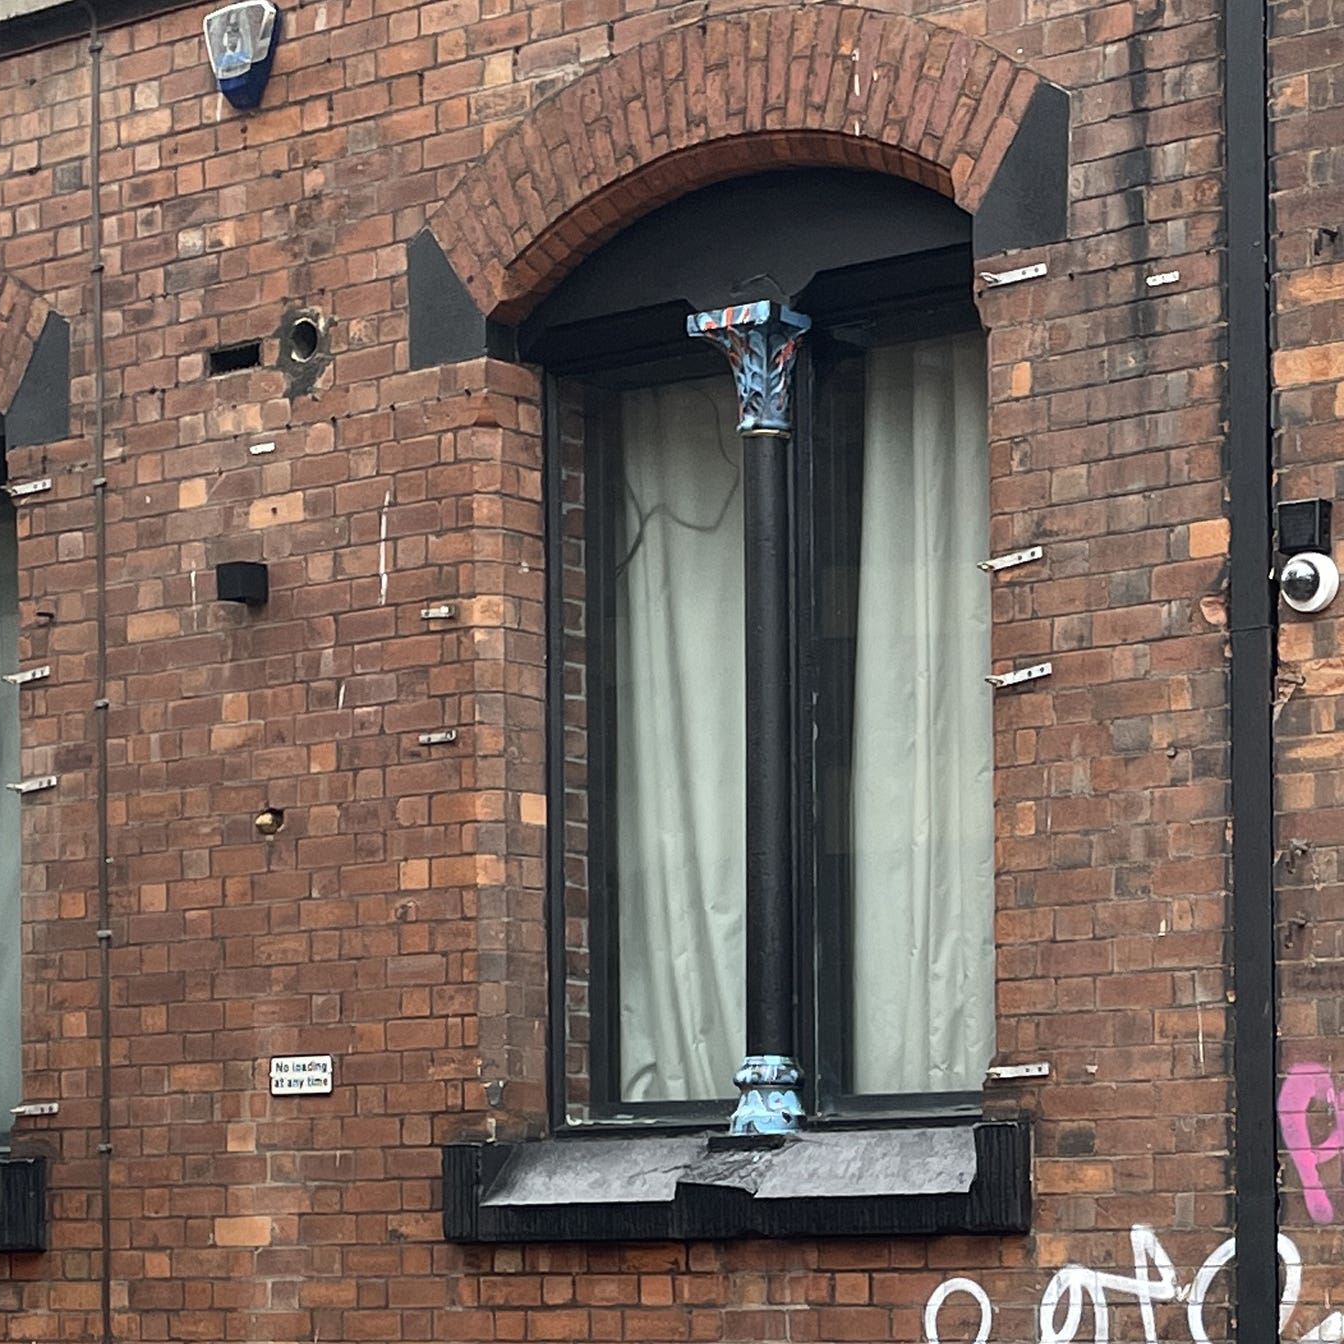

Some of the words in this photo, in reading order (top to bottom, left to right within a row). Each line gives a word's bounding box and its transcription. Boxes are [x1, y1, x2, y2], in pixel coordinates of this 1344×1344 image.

[275, 1062, 289, 1073] No
[292, 1060, 328, 1073] loading
[274, 1077, 284, 1088] at
[287, 1078, 304, 1089] any
[307, 1076, 328, 1087] time
